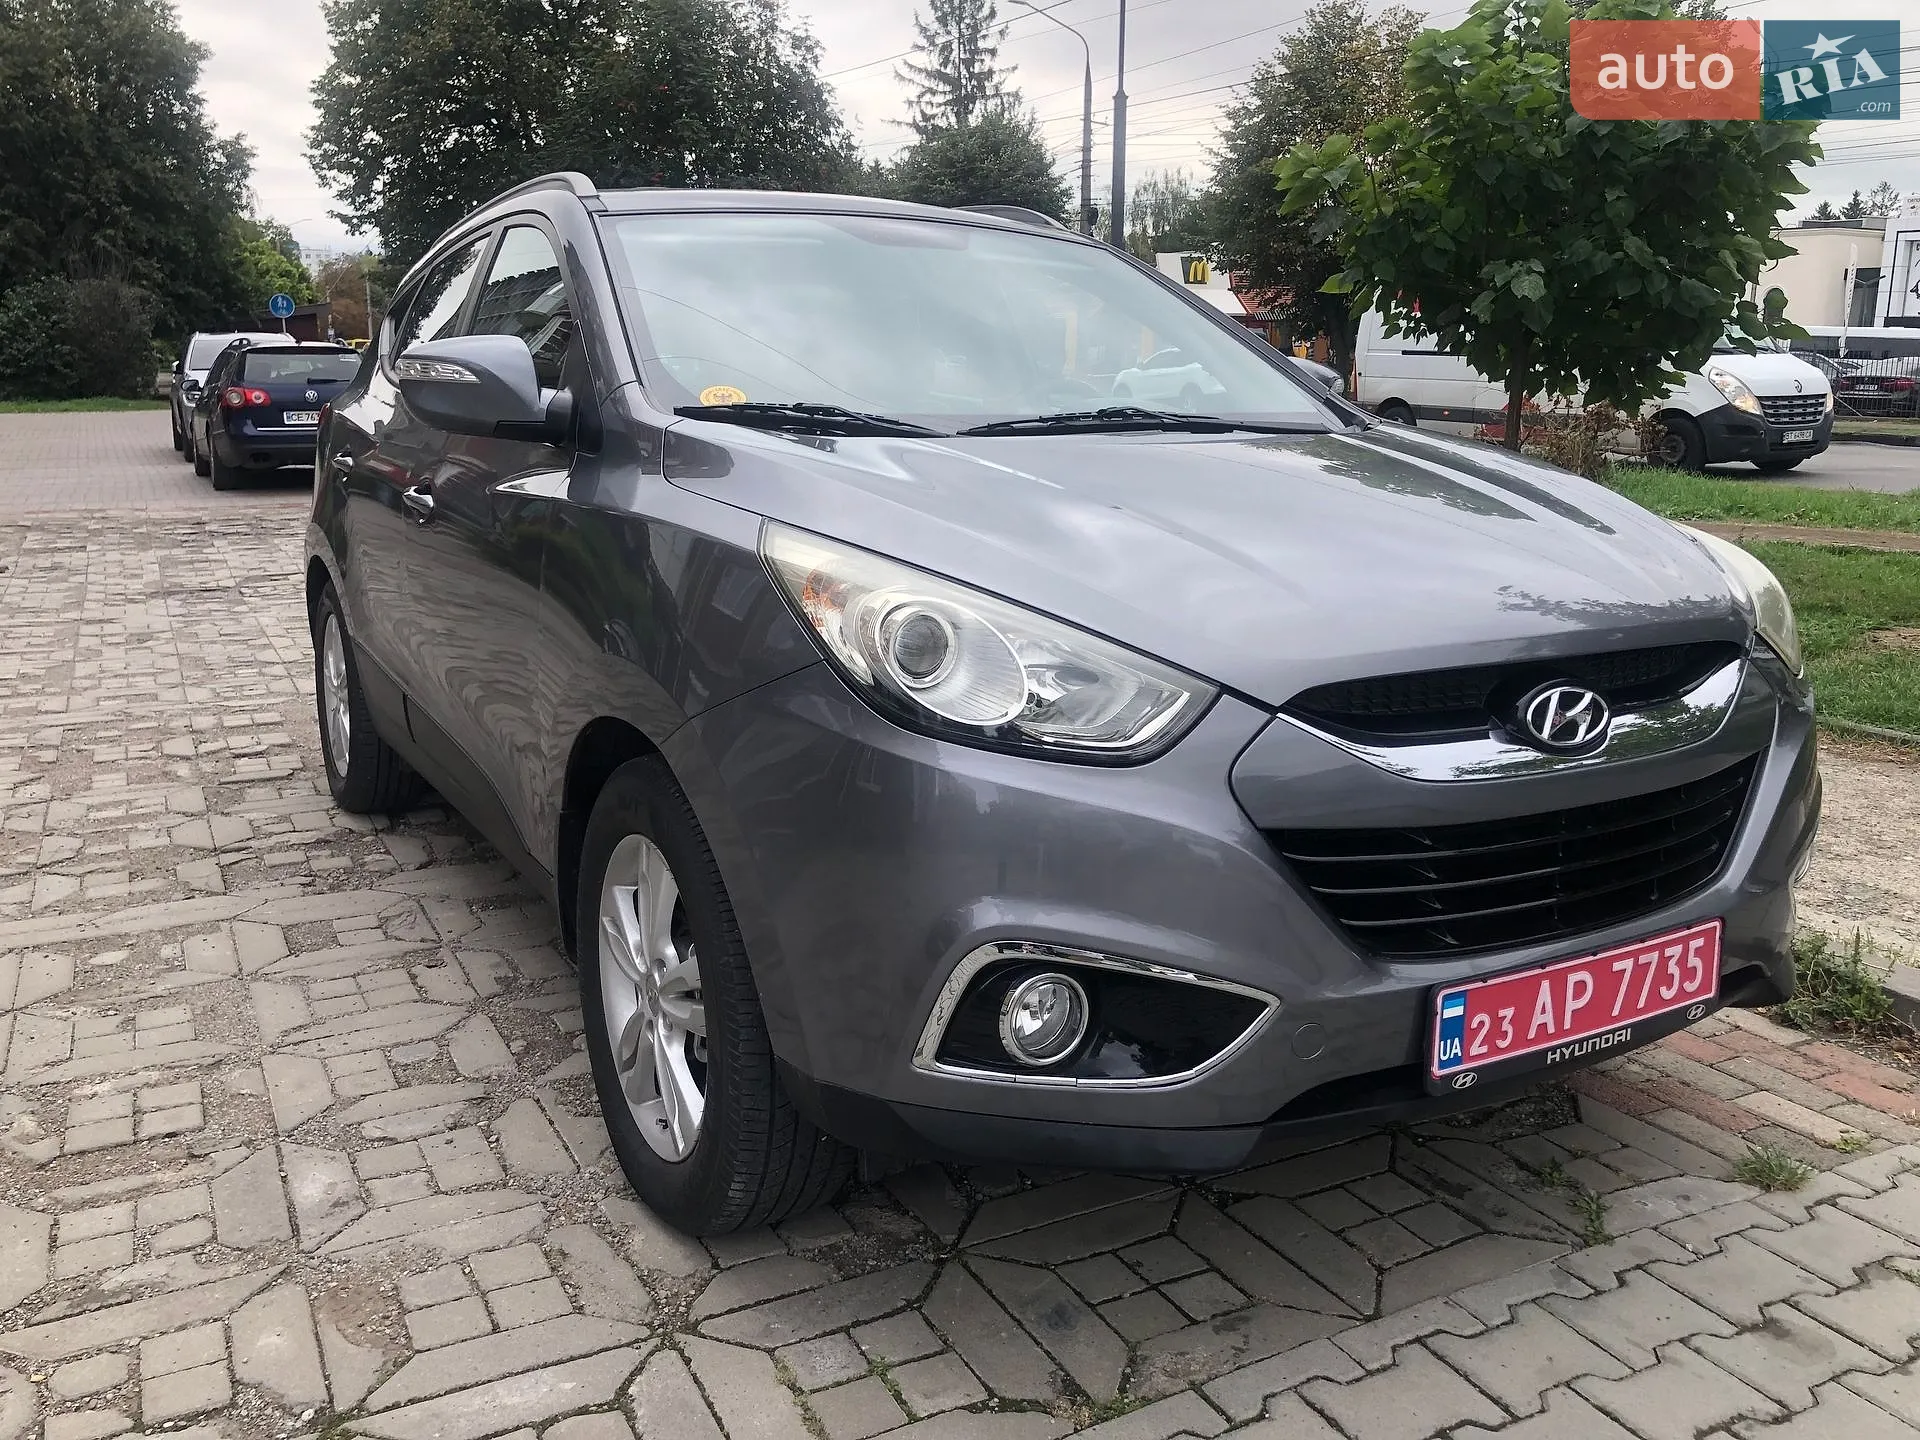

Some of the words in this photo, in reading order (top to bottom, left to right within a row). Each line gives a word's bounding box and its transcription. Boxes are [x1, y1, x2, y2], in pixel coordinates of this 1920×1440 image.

[291, 413, 304, 421] CE
[1469, 1007, 1515, 1057] 23
[1527, 970, 1594, 1040] AP
[1611, 937, 1705, 1017] 7735
[1440, 1038, 1462, 1061] UA
[1547, 1028, 1631, 1064] HYUNDAI
